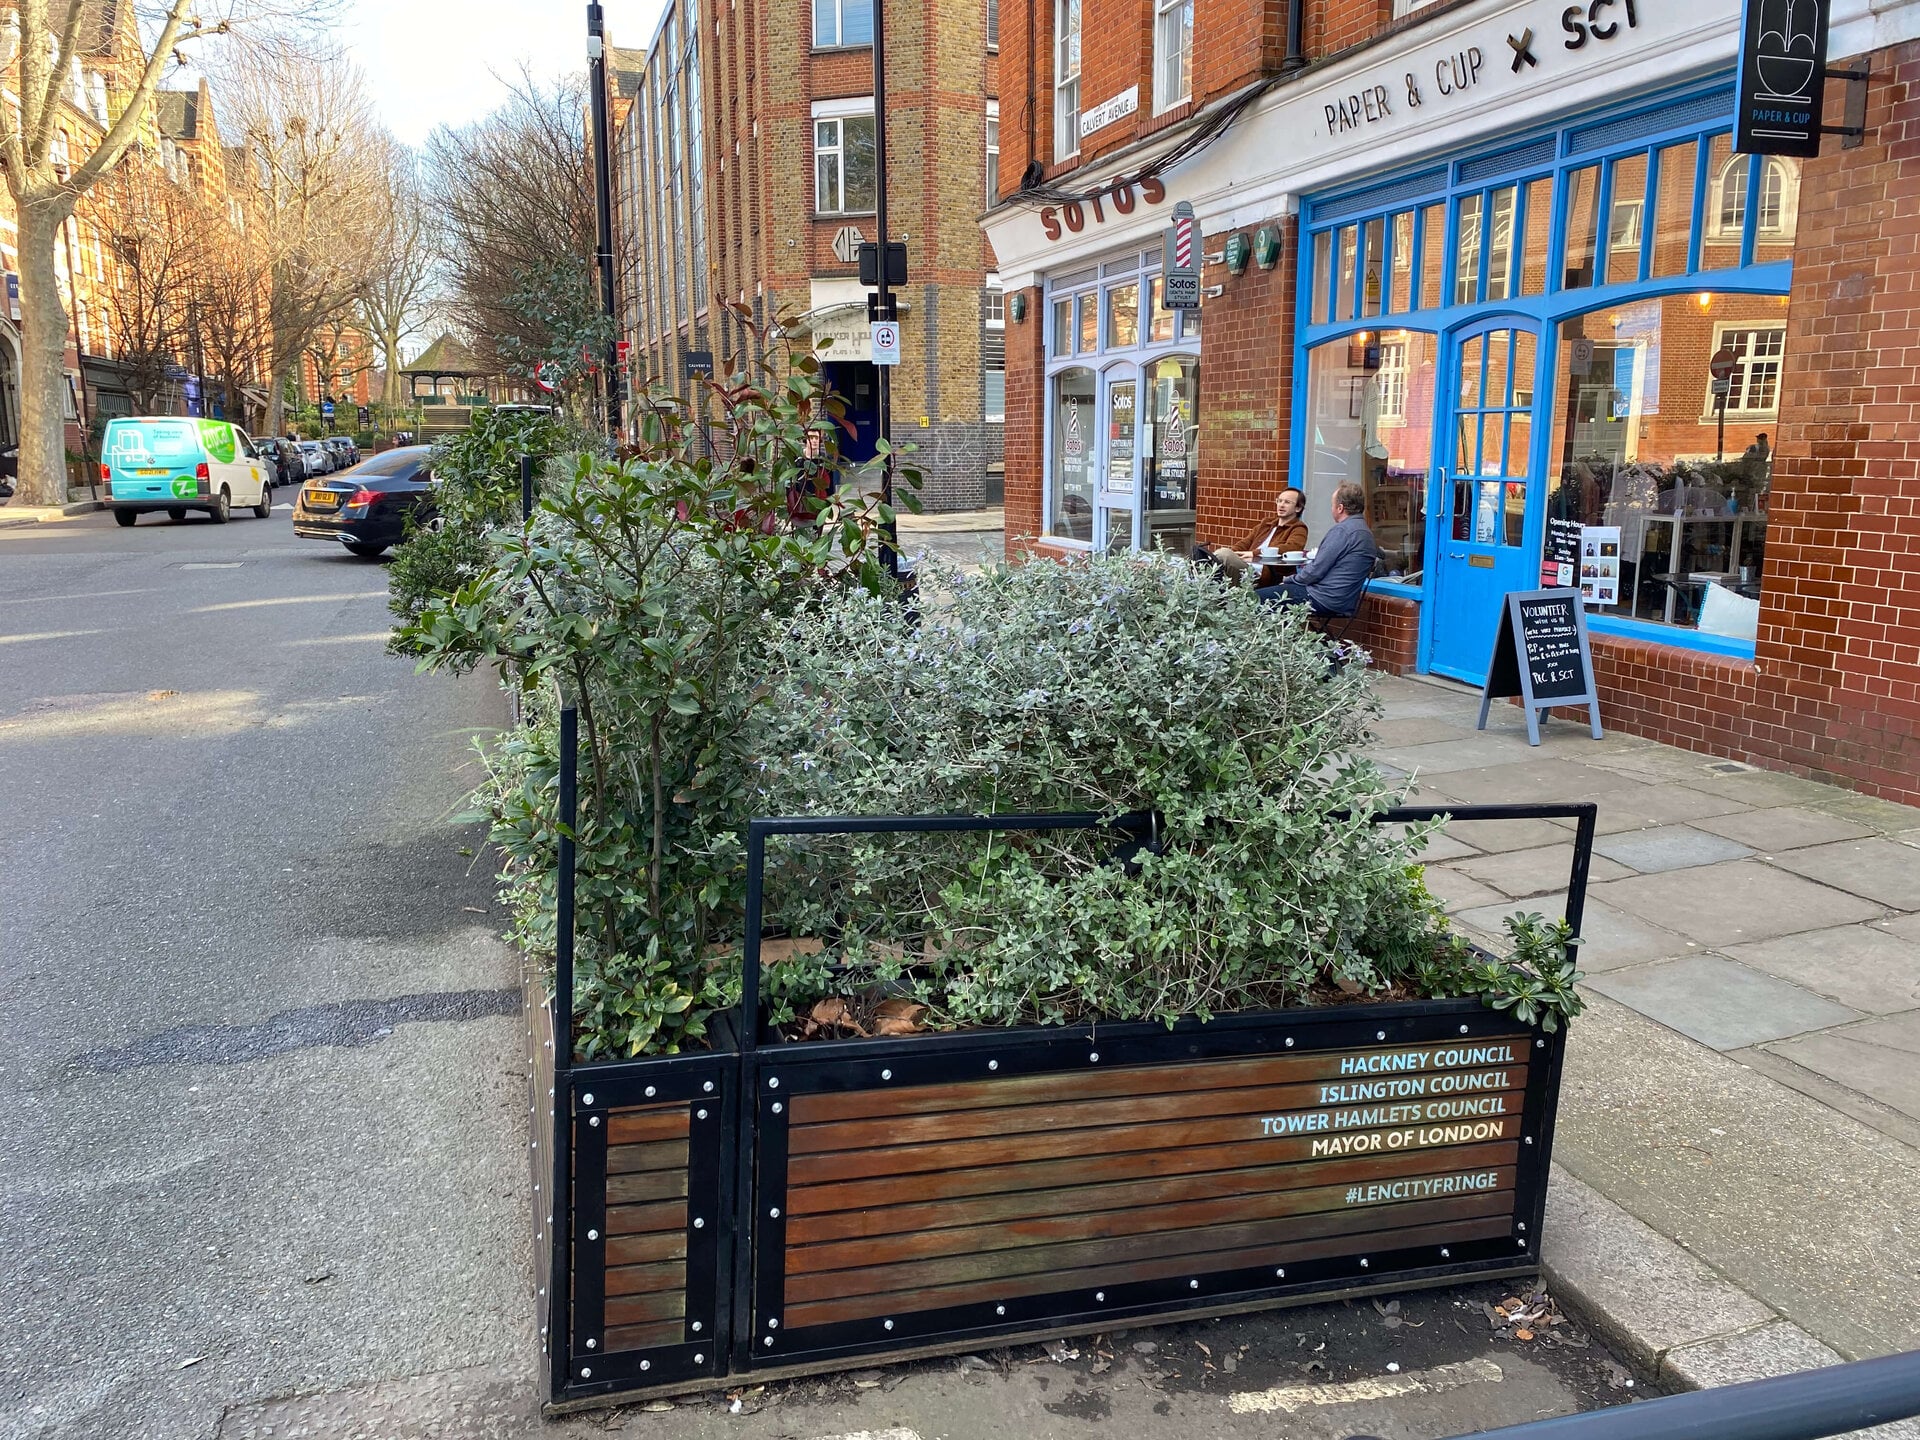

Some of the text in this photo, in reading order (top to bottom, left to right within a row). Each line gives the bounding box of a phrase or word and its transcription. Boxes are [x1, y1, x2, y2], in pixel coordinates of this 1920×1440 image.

[1324, 85, 1391, 136] PAPER
[1405, 73, 1421, 108] &
[1435, 47, 1484, 96] CUP
[1083, 112, 1105, 134] CALVERT
[1108, 99, 1129, 121] AVENUE
[1752, 109, 1810, 124] PAPER & CUP
[1041, 165, 1165, 241] SOTOS
[1170, 278, 1196, 289] Sotos
[1114, 394, 1132, 410] Sotos
[1550, 518, 1571, 528] Opening
[1522, 604, 1569, 618] VOLUNTEER
[1559, 669, 1574, 680] SCT
[1340, 1046, 1514, 1074] HACKNEY COUNCIL
[1320, 1072, 1510, 1104] ISLINGTON COUNCIL
[1261, 1098, 1506, 1134] TOWER HAMLETS COUNCIL
[1312, 1122, 1504, 1157] MAYOR OF LONDON
[1346, 1172, 1498, 1204] #LENCITYFRINGE
